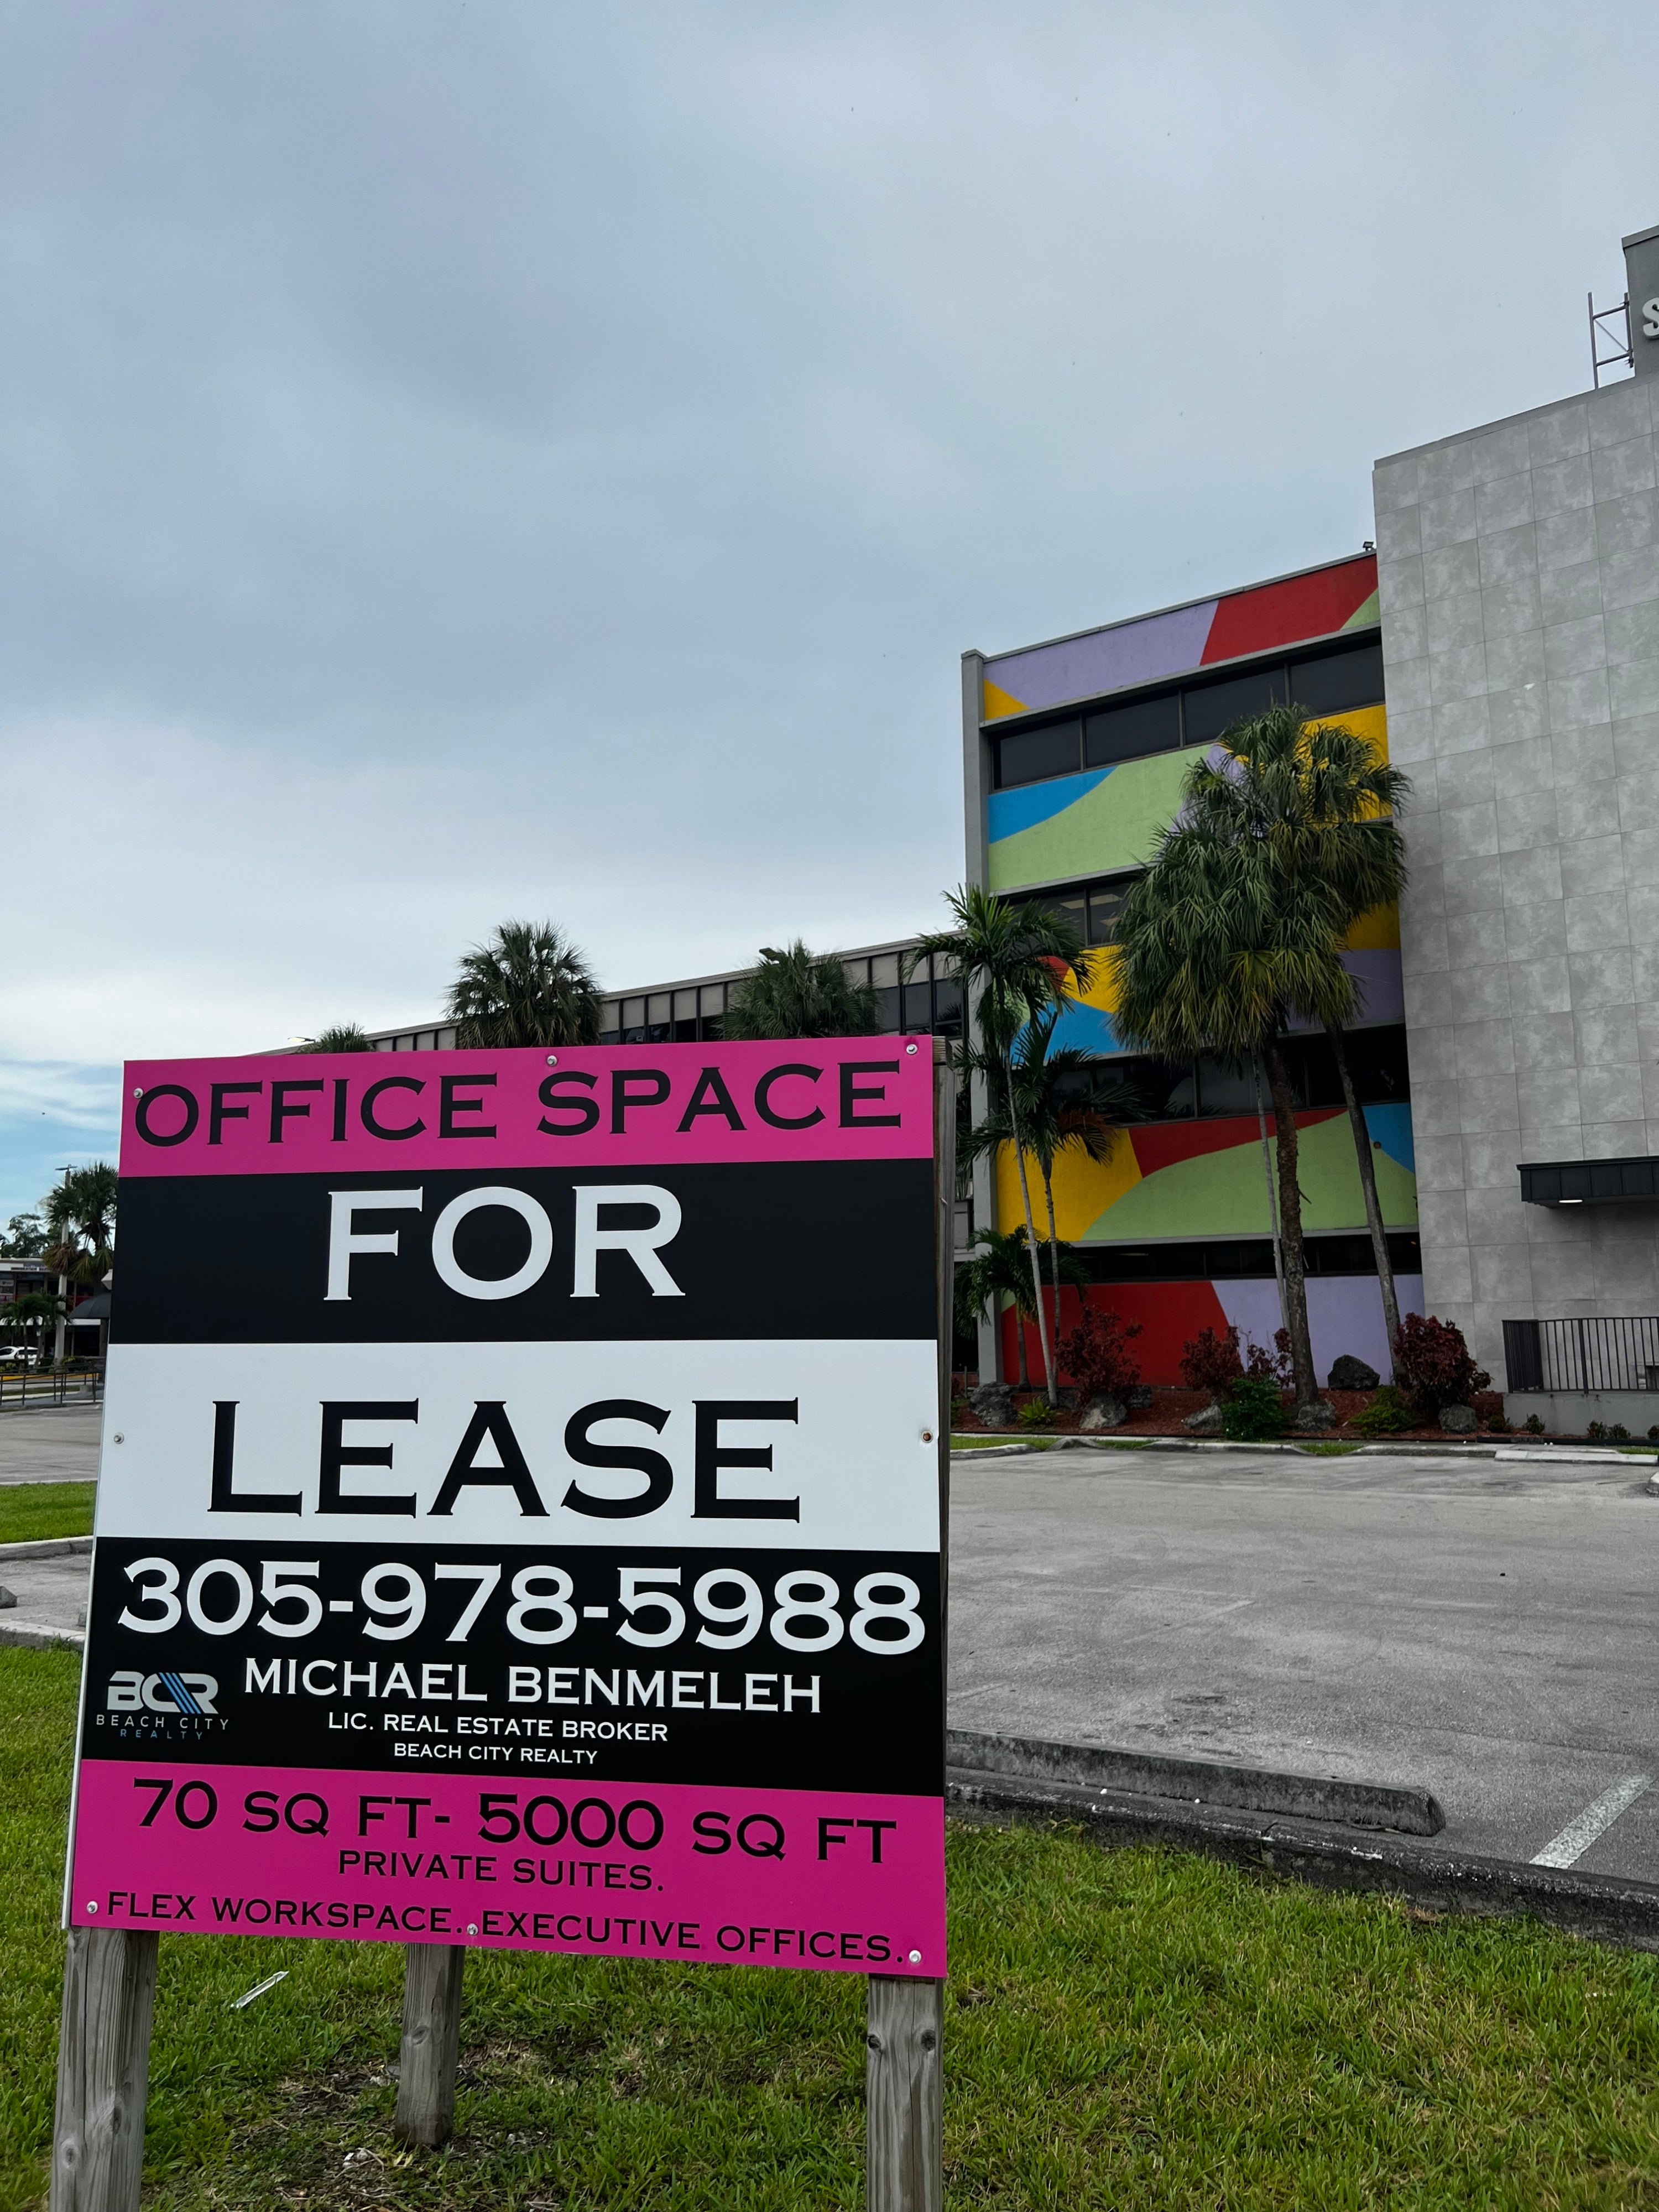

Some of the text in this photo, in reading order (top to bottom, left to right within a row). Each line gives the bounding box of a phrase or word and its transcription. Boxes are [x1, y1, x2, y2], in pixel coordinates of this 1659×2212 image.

[135, 1059, 901, 1147] OFFICE SPACE
[323, 1185, 686, 1301] FOR
[207, 1397, 800, 1524] LEASE
[117, 1557, 925, 1655] 305-978-5988
[244, 1657, 821, 1713] MICHAEL BENMELEH
[96, 1714, 229, 1730] BEACH CITY
[119, 1728, 203, 1740] REALTY
[328, 1712, 667, 1741] LIC. REAL ESTATE BROKER
[394, 1743, 598, 1764] BEACH CITY REALTY
[133, 1777, 897, 1864] 70 SQ FT- 5000 SQ FT
[339, 1850, 663, 1891] PRIVATE SUITES.
[108, 1891, 903, 1963] FLEX WORKSPACE. EXECUTIVE OFFICES.
